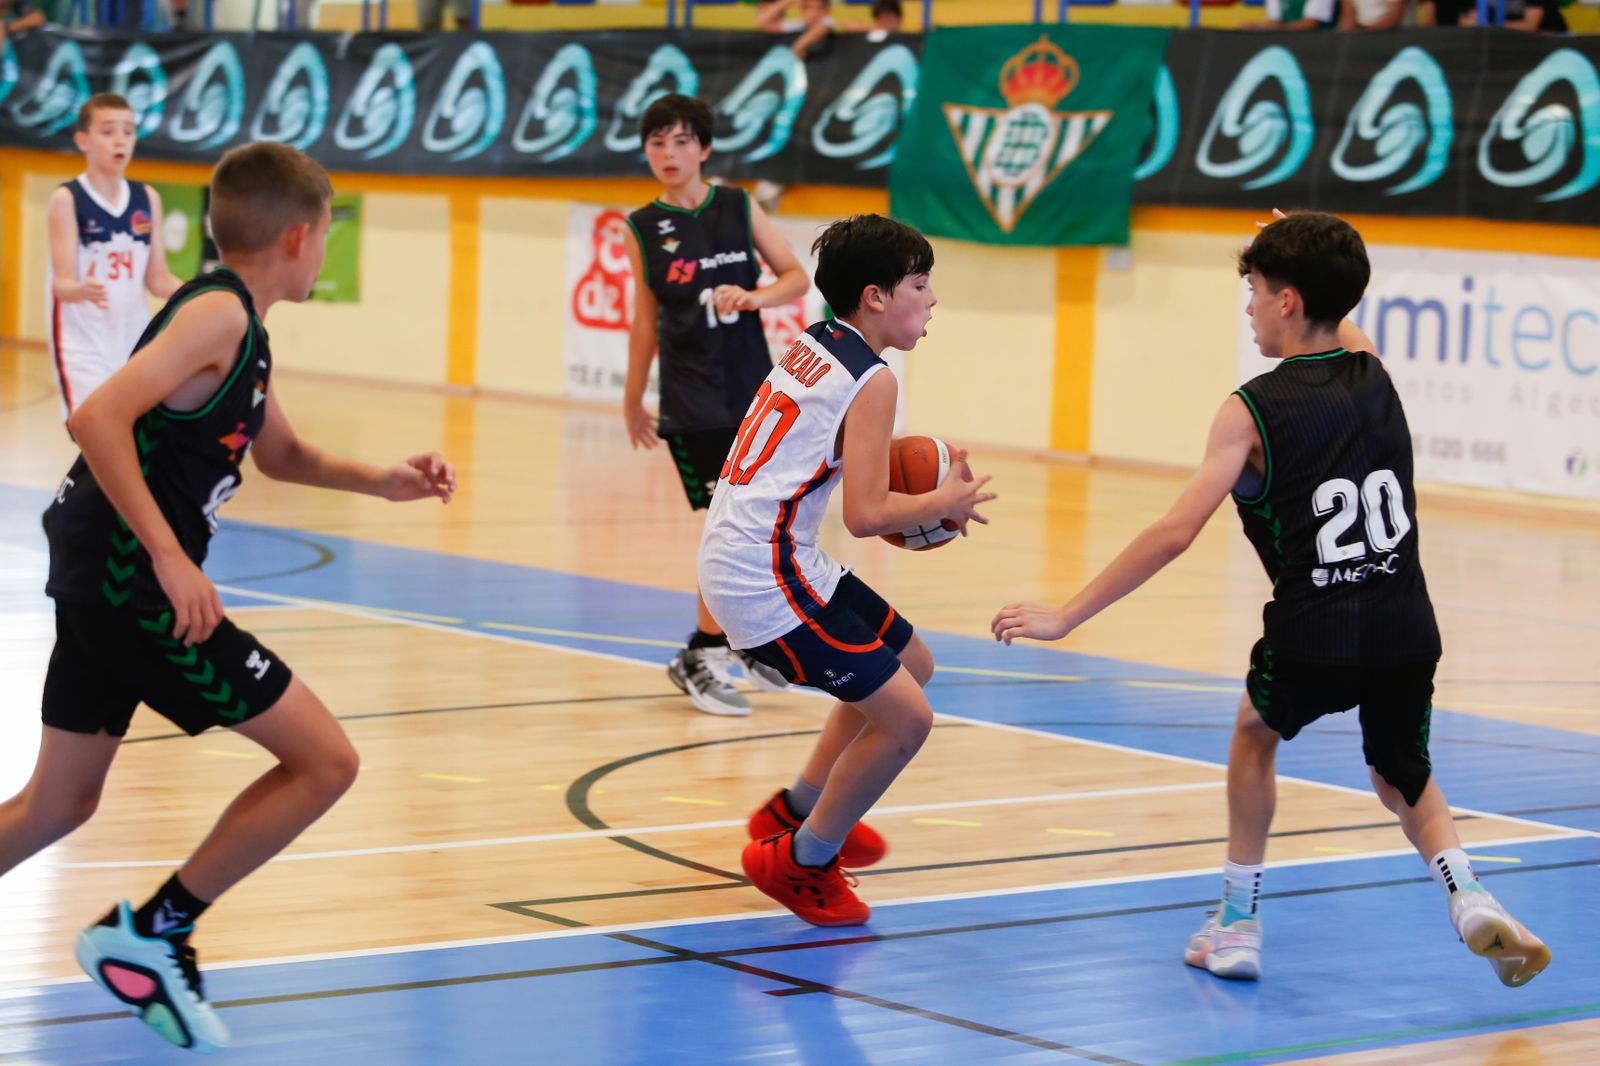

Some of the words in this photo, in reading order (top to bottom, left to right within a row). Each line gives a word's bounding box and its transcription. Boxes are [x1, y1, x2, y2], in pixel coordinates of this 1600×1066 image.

[107, 251, 133, 280] 34
[1357, 276, 1600, 376] mitec
[778, 340, 832, 388] ONZALO
[1311, 469, 1411, 564] 20
